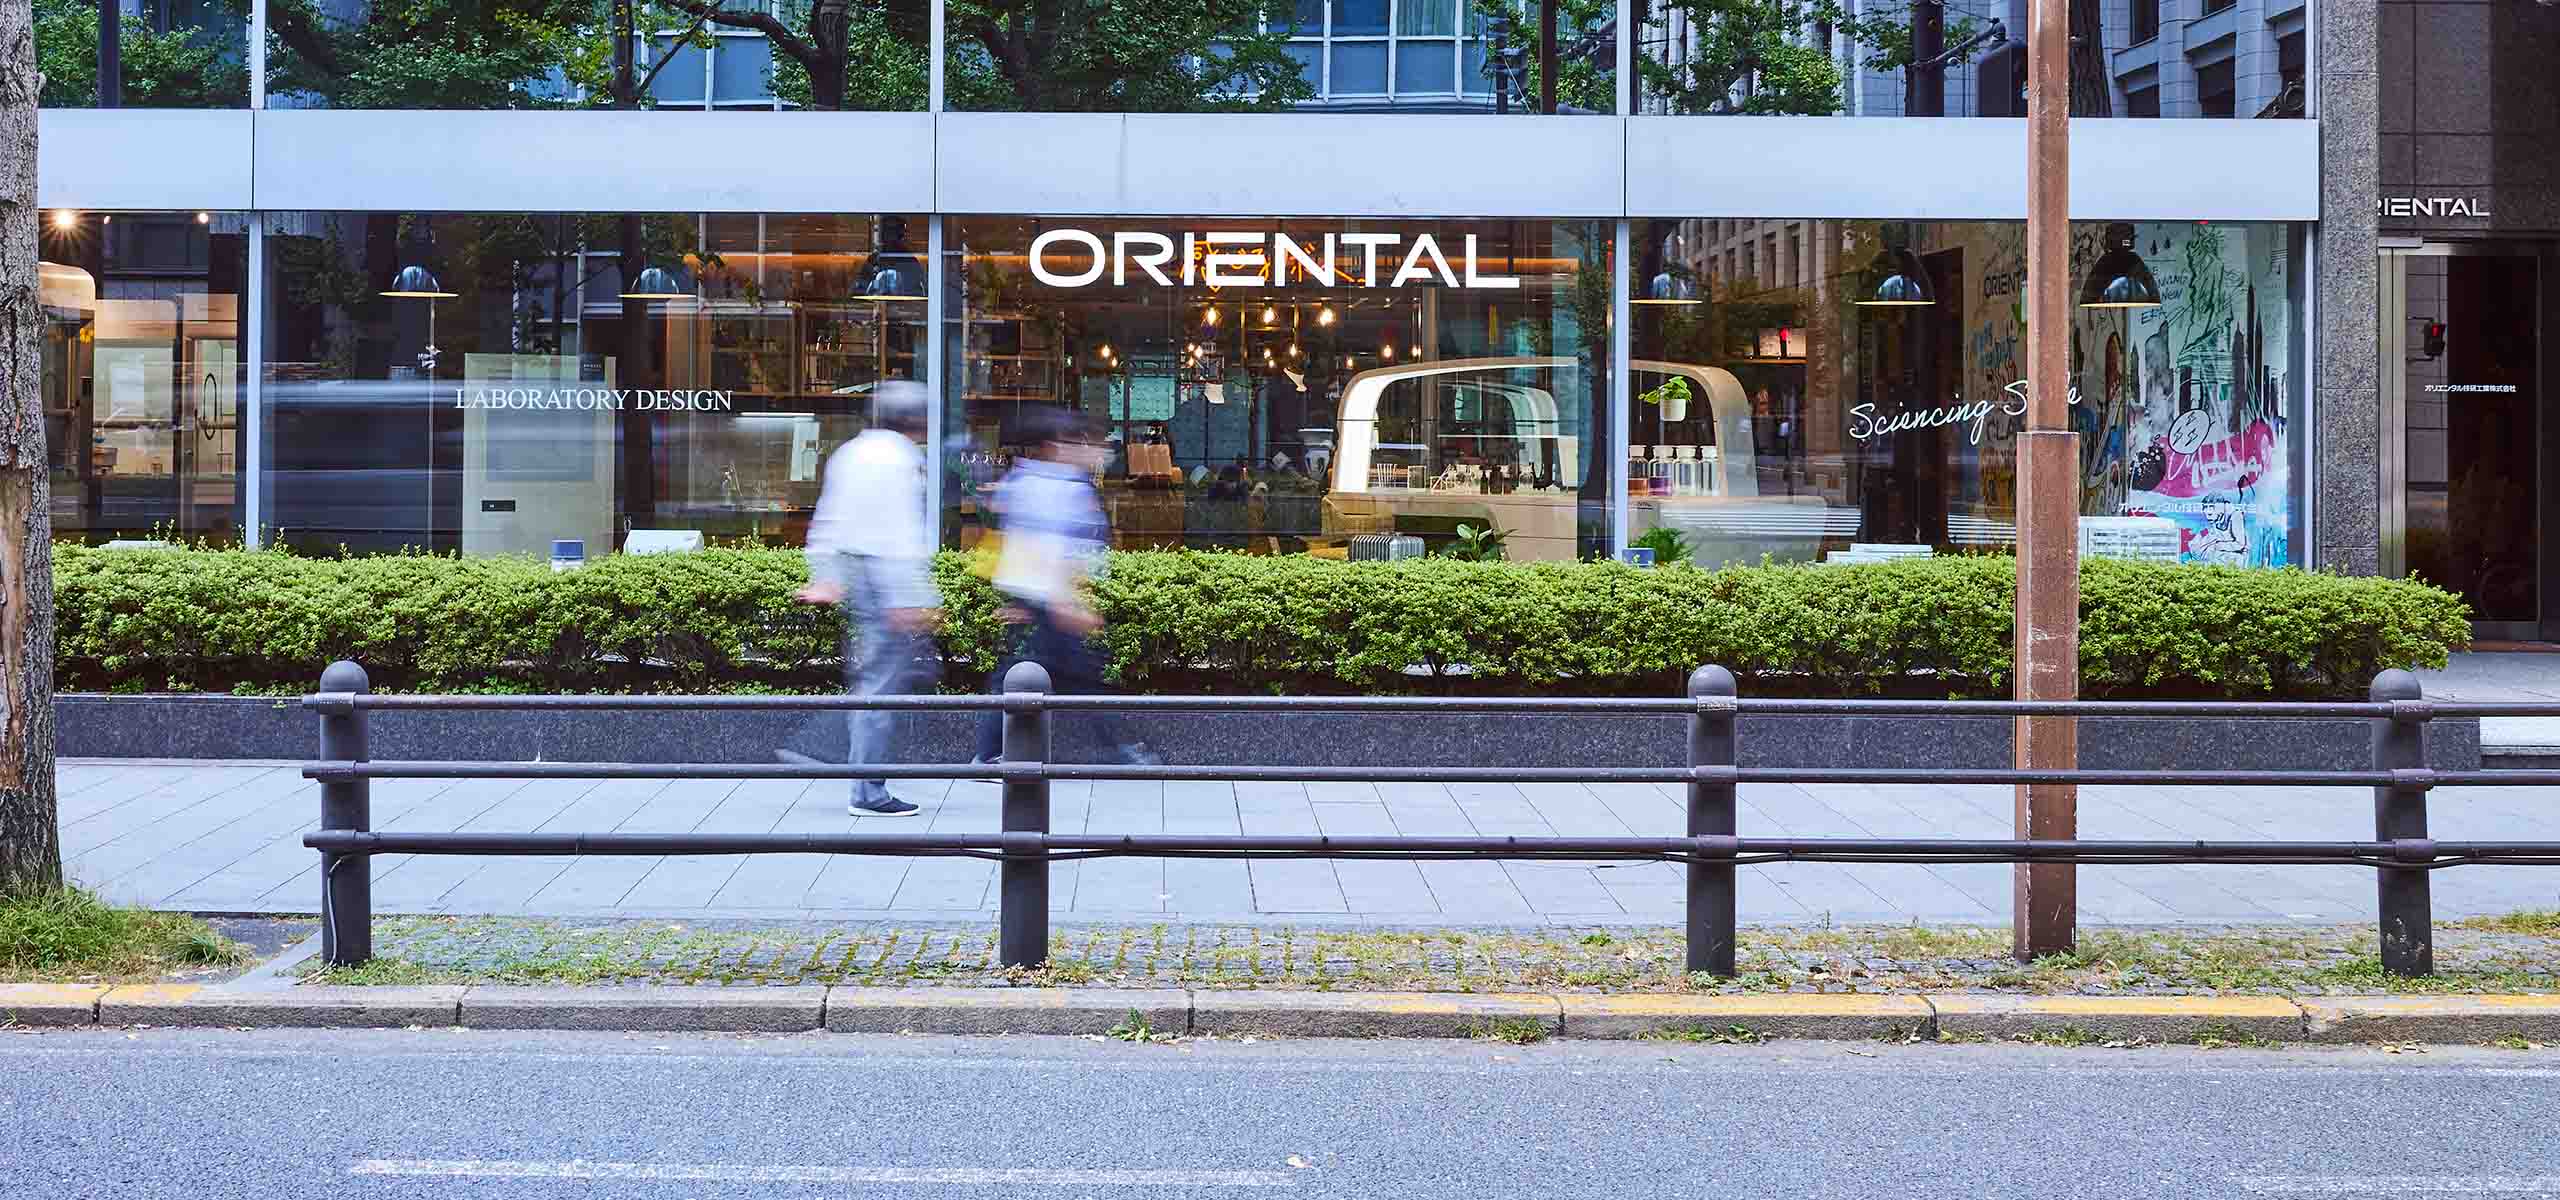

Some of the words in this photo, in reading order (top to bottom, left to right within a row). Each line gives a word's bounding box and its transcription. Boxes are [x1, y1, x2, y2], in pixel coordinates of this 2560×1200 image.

[2378, 198, 2490, 217] IENTAL
[1029, 229, 1519, 288] ORIENTAL
[456, 388, 629, 410] LABORATORY
[634, 389, 732, 411] DESIGN
[1849, 394, 1995, 446] Sciencing
